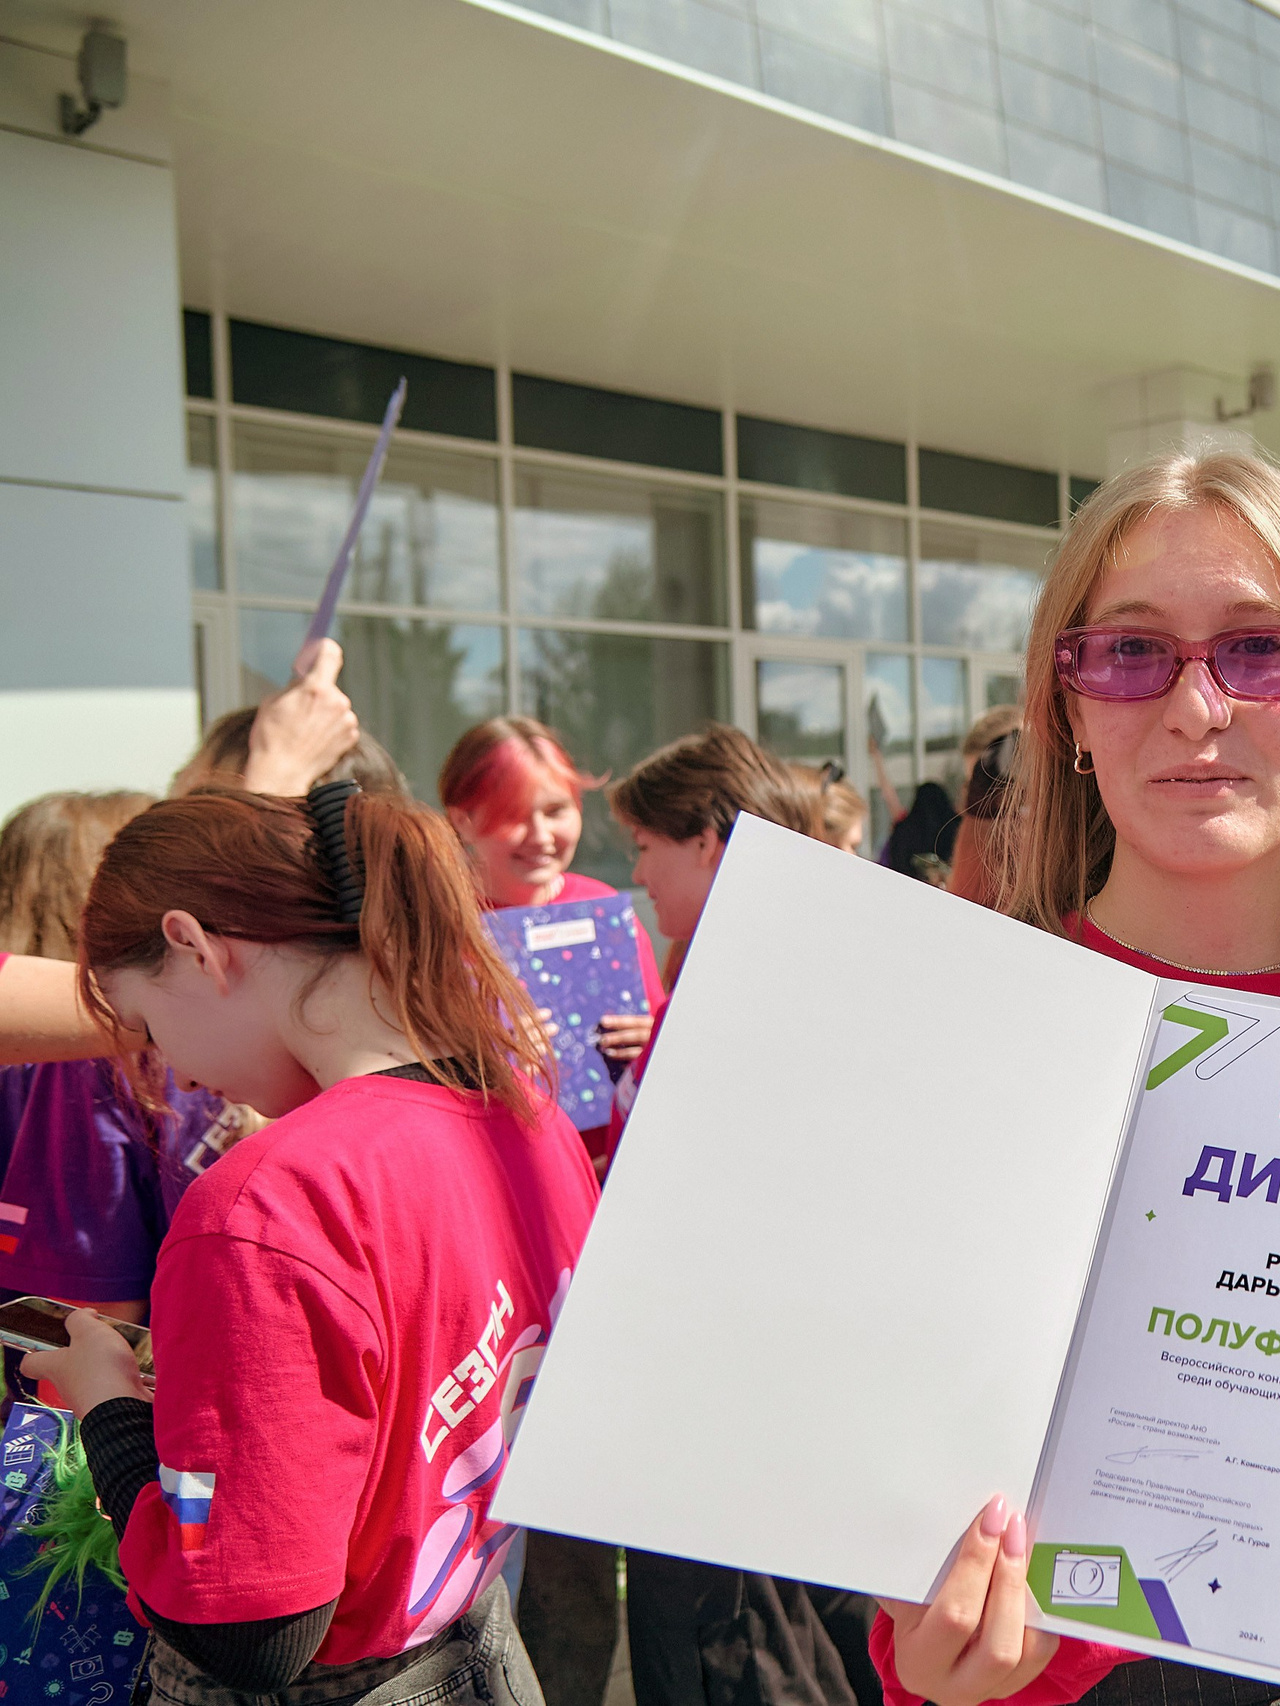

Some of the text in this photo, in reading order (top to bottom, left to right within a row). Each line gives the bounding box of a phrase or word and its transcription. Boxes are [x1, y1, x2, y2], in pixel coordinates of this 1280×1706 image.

[184, 1103, 245, 1176] СЕЗ
[1160, 1350, 1255, 1379] Всероссийского
[1177, 1371, 1213, 1389] среди
[1109, 1407, 1208, 1433] Генеральный директор АНО
[1142, 1426, 1166, 1435] страна
[1095, 1468, 1251, 1509] Председатель Правления Общероссийского
[1090, 1489, 1126, 1502] движения
[1126, 1495, 1147, 1506] детей
[1154, 1502, 1191, 1516] молодежи
[1248, 1536, 1271, 1549] Гуров
[1239, 1630, 1258, 1641] 2024
